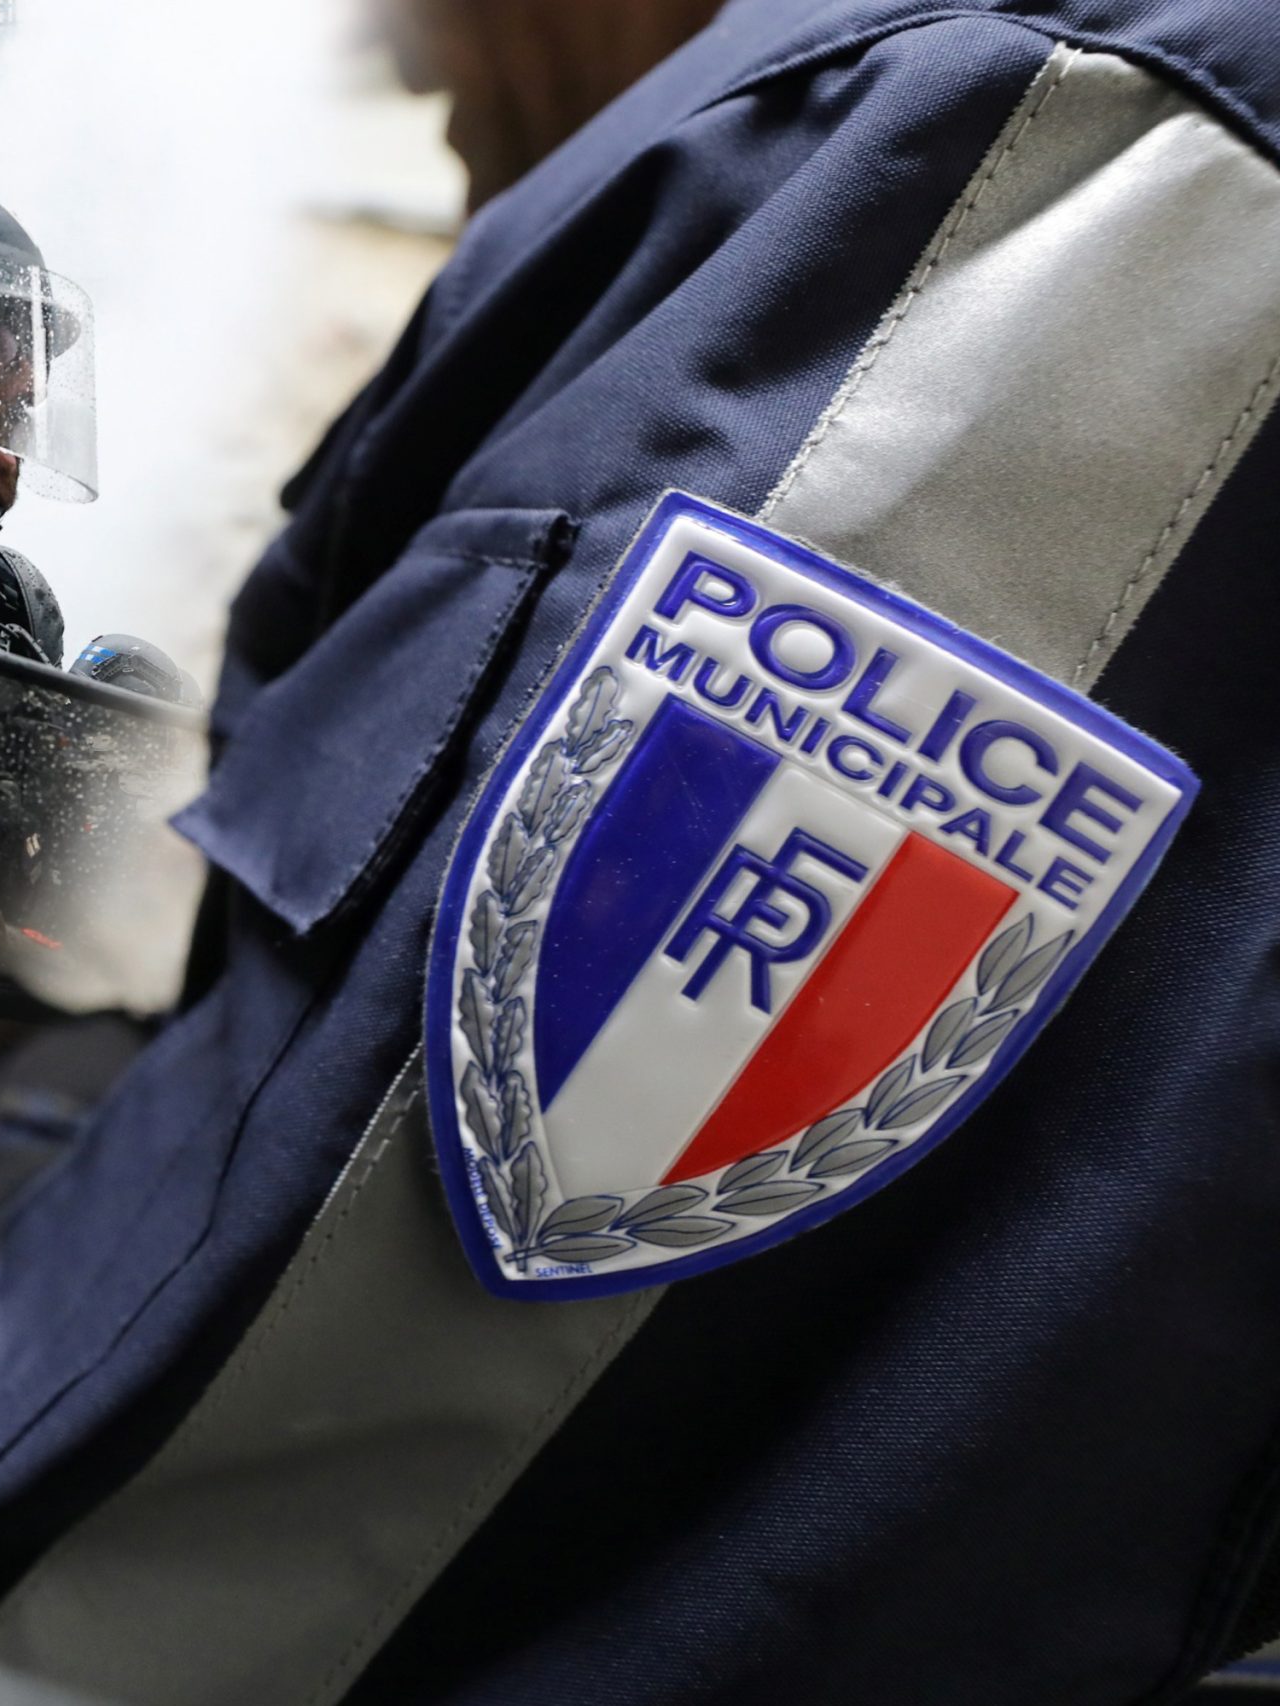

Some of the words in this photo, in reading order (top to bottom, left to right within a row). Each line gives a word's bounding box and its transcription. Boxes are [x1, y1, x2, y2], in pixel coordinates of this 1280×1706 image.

[624, 625, 1094, 910] MUNICIPALE
[654, 550, 1142, 864] POLICE
[536, 1264, 593, 1278] SENTINEL
